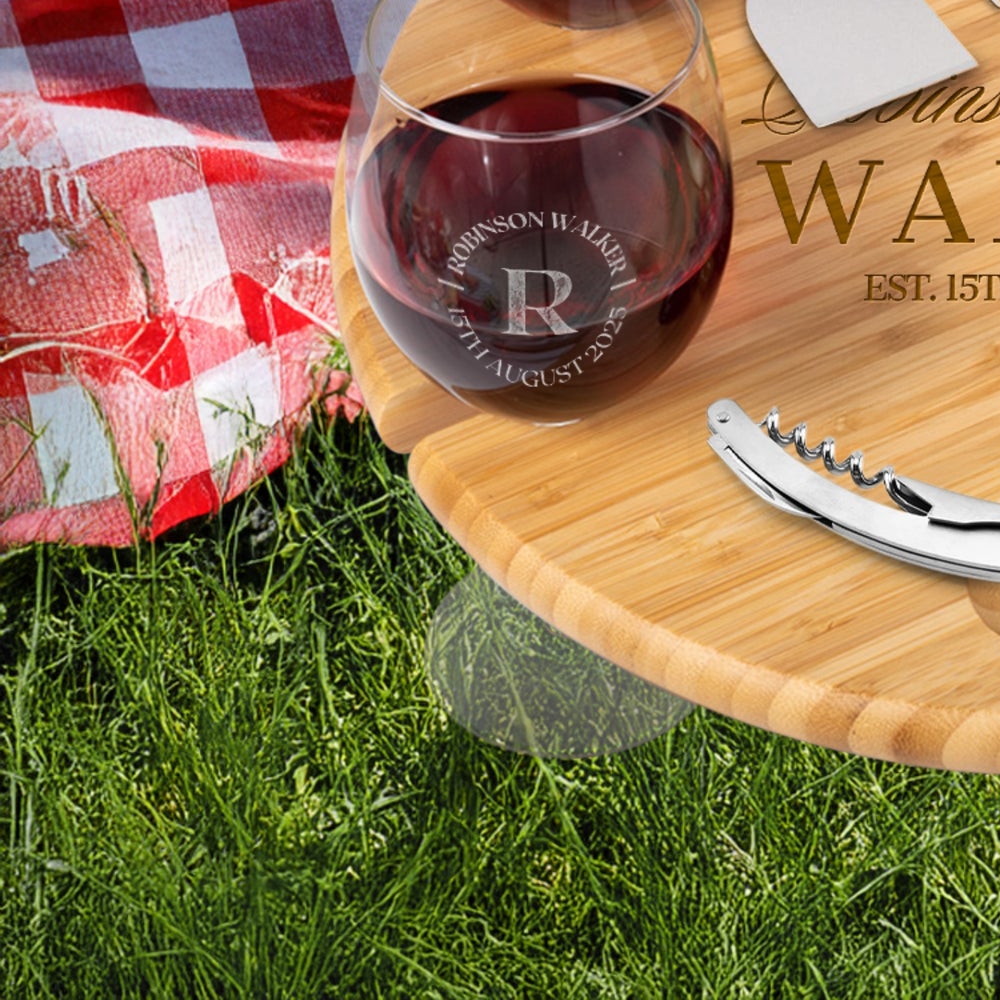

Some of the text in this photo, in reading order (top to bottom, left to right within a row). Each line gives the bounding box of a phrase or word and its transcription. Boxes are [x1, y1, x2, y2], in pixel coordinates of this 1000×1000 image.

[447, 211, 628, 276] ROBINSON WALKER
[500, 267, 579, 336] R
[864, 273, 937, 301] EST.
[448, 306, 627, 388] 15TH AUGUST 2025
